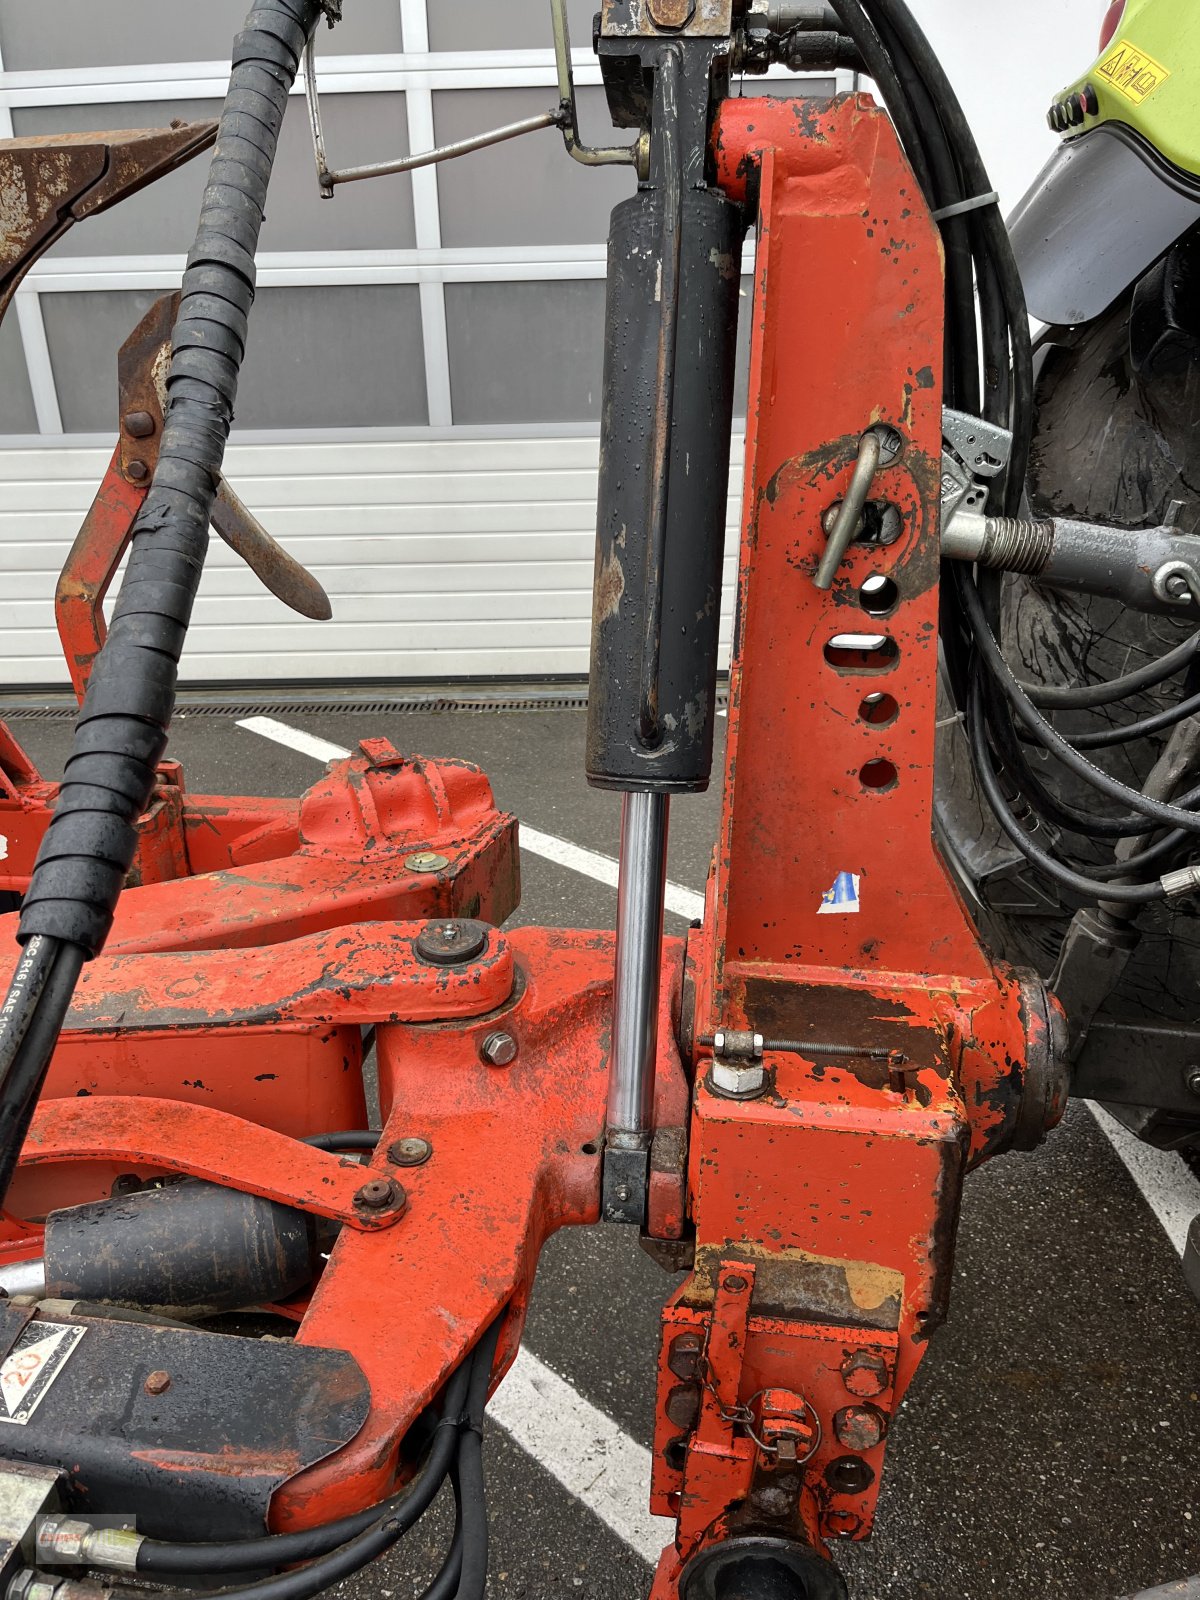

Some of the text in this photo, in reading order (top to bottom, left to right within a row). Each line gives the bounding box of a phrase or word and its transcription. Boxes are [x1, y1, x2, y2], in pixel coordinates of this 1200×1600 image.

[26, 934, 42, 957] 2SC
[16, 959, 33, 981] R16
[2, 989, 20, 1014] SAE
[4, 1353, 42, 1387] 20
